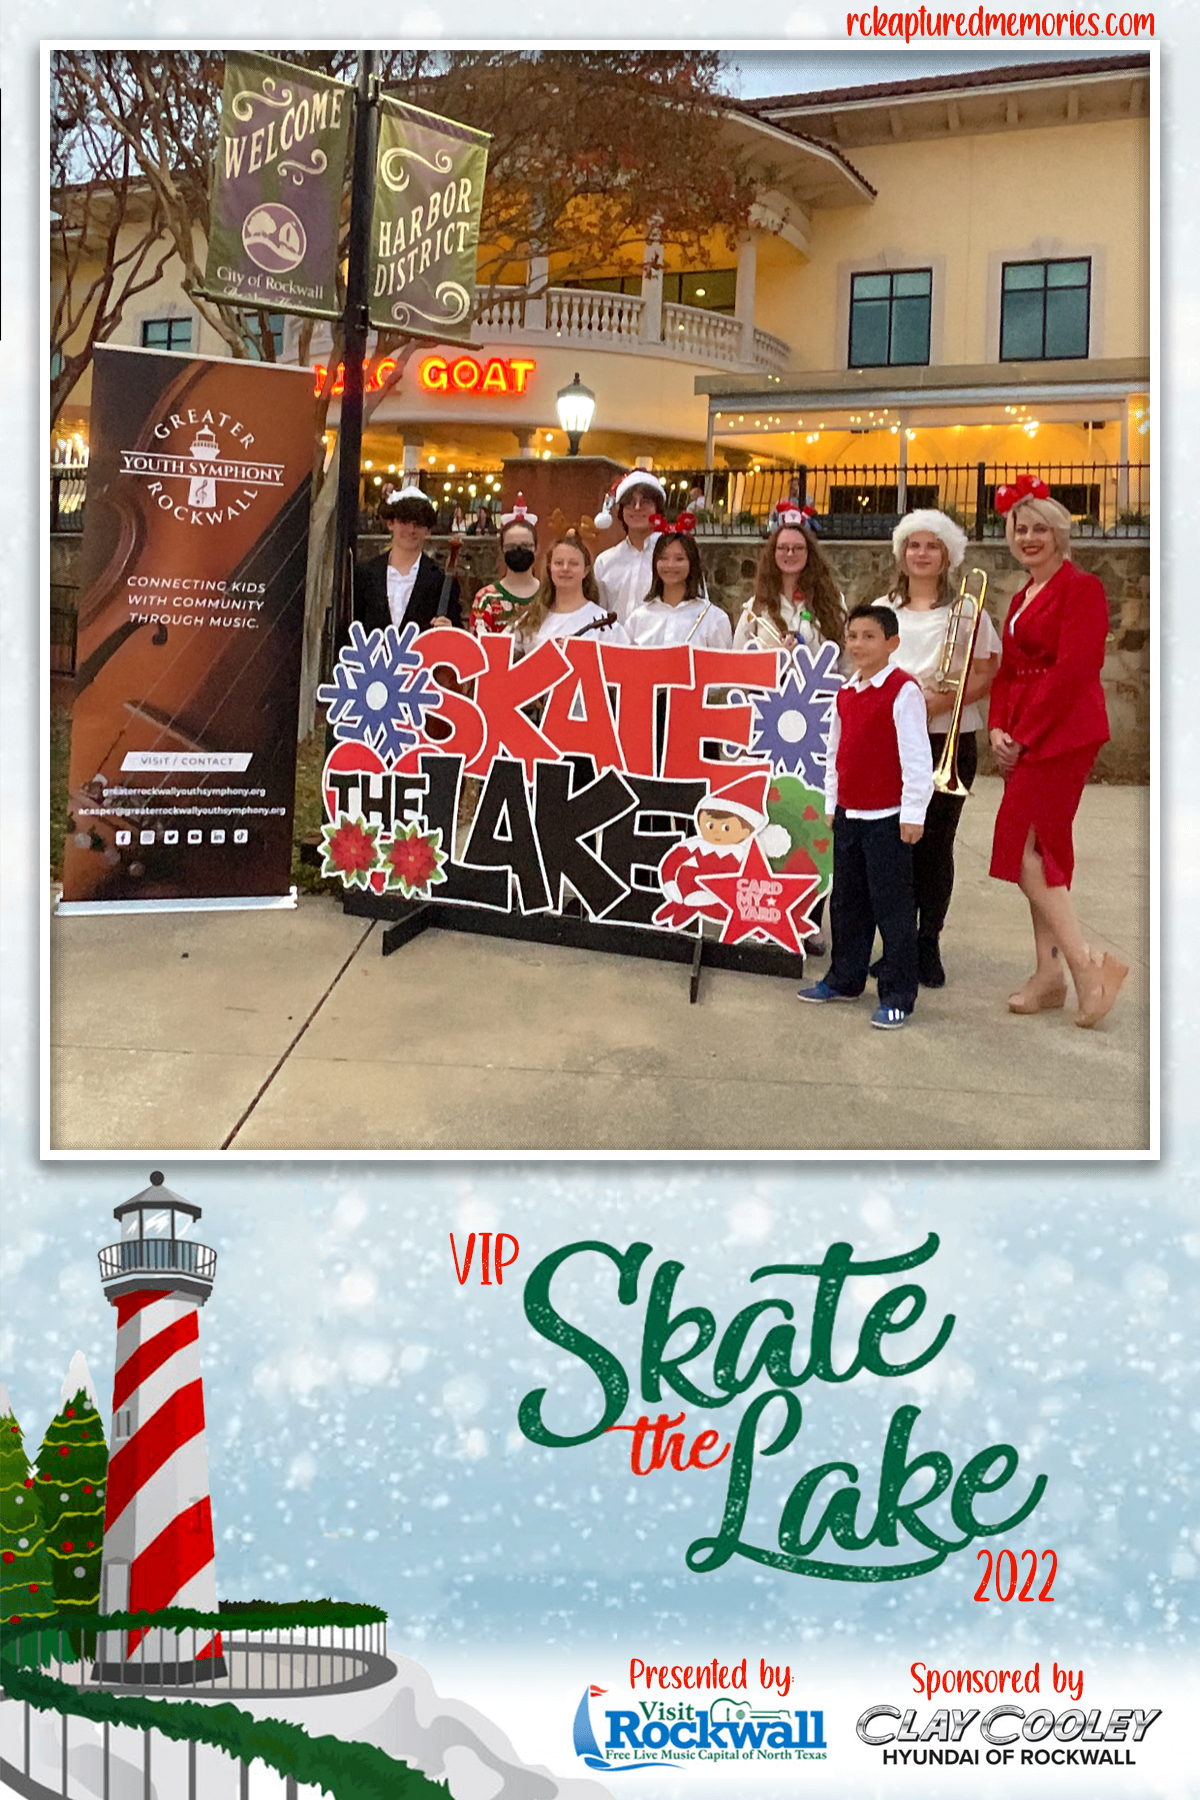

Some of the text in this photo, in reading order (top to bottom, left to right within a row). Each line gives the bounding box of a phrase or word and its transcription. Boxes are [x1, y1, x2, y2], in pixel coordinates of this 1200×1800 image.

[224, 89, 345, 179] WELCOME
[378, 178, 472, 257] HARBOR
[373, 222, 470, 297] DISTRICT
[216, 266, 245, 286] City
[247, 273, 264, 287] of
[265, 276, 324, 299] Rockwall
[419, 355, 536, 394] GOAT
[154, 409, 255, 449] GREATER
[124, 456, 284, 482] YOUTH SYMPHONY
[147, 481, 258, 525] ROCKWALL
[127, 576, 266, 593] CONNECTING KIDS
[128, 595, 265, 611] WITH COMMUNITY
[130, 613, 259, 629] THROUGH MUSIC.
[400, 626, 788, 795] SKATE
[140, 757, 169, 766] VISIT
[181, 757, 234, 766] CONTACT
[102, 786, 266, 798] greaterrockwallyouthsymphony.org
[327, 769, 430, 834] THE
[414, 753, 710, 937] LAKE
[736, 878, 783, 895] CARD
[736, 891, 765, 907] MY
[740, 906, 781, 923] YARD
